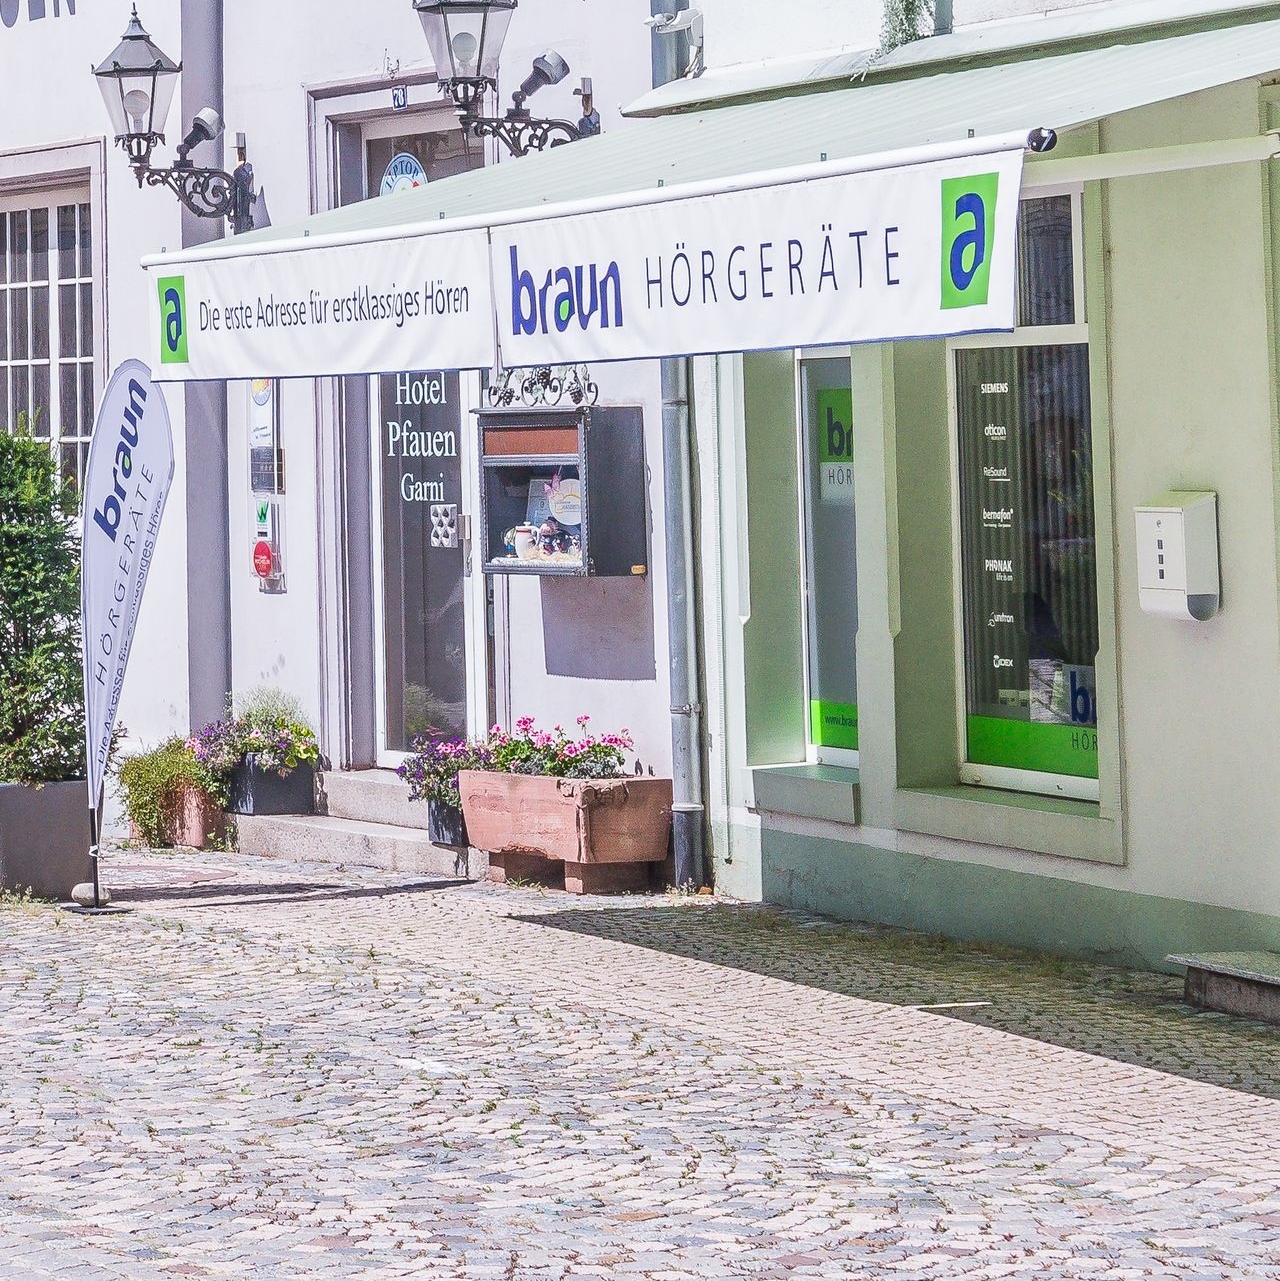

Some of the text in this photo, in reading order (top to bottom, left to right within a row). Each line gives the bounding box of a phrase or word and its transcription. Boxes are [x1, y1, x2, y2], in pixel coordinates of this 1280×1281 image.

[393, 88, 405, 107] 78
[509, 223, 900, 335] braun HÖRGERÄTE
[200, 280, 469, 331] Die erste Adresse für erstklassiges Hören
[395, 371, 447, 405] Hotel
[981, 382, 1009, 394] SIEMENS
[387, 419, 457, 457] Pfauen
[984, 423, 1007, 436] oticon
[93, 378, 148, 543] braun
[983, 467, 1007, 476] ReSound
[401, 472, 445, 502] Garni
[96, 464, 154, 686] HÖRGERÄTE
[985, 559, 1012, 572] PHONAK
